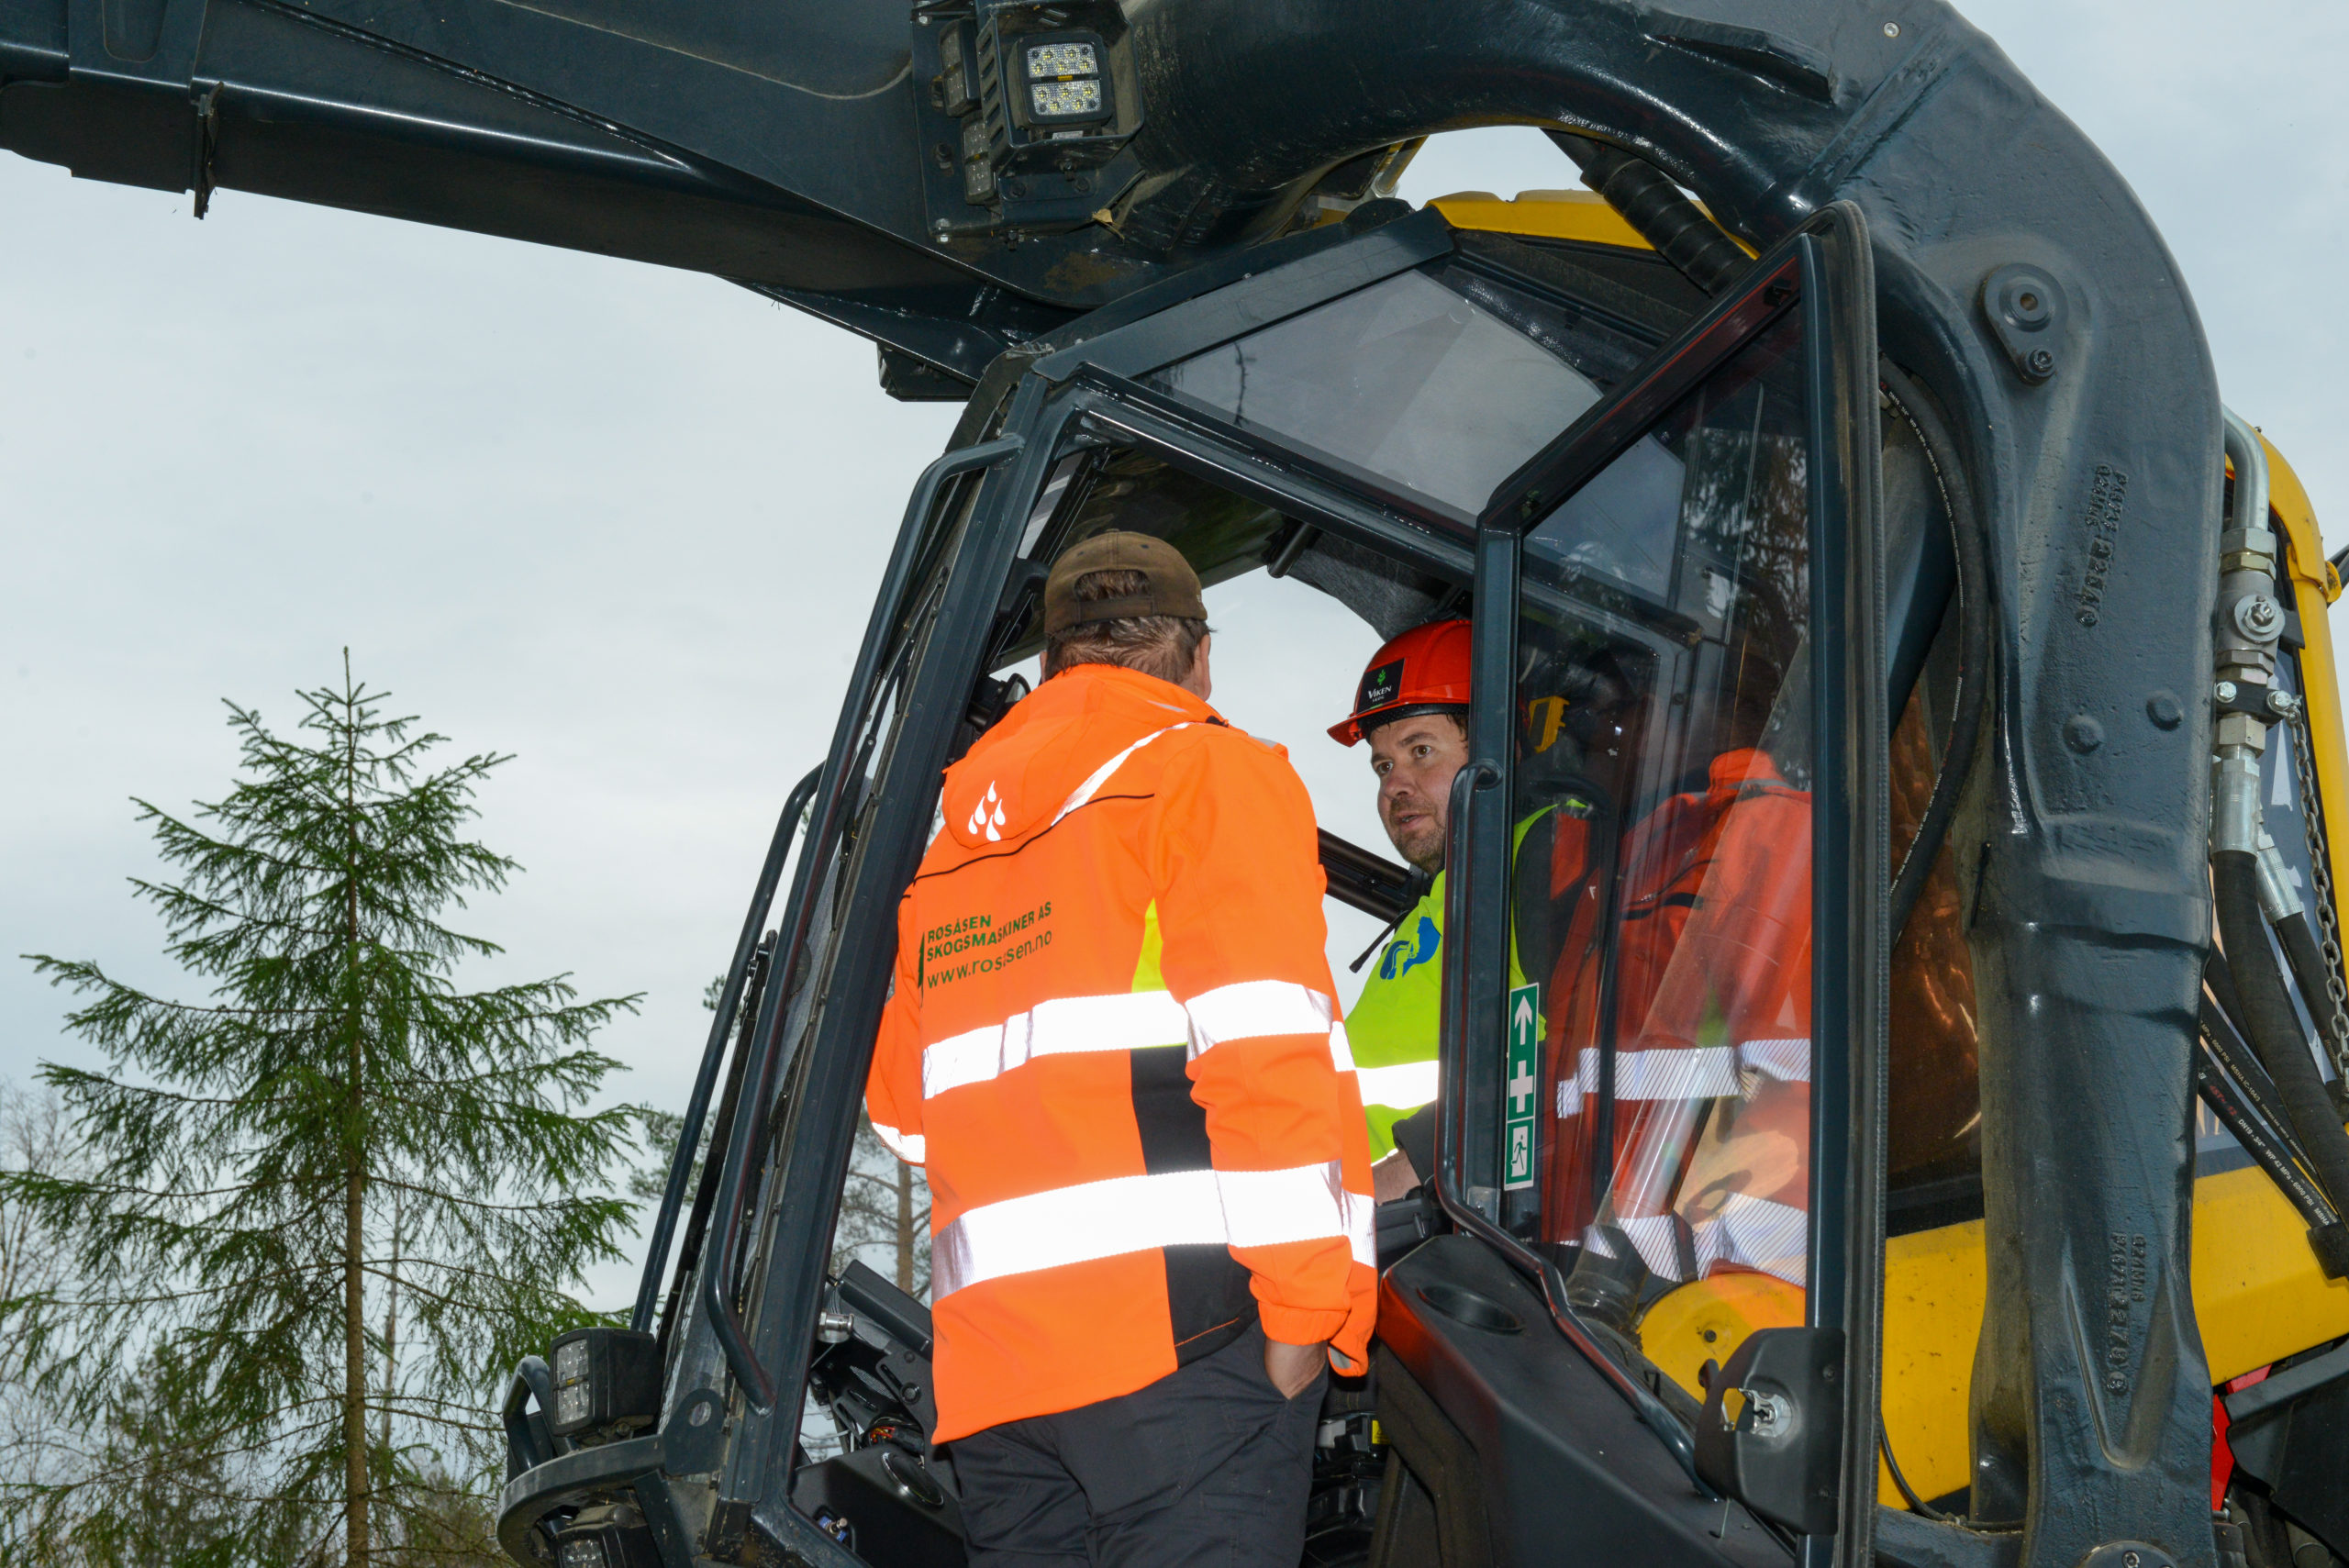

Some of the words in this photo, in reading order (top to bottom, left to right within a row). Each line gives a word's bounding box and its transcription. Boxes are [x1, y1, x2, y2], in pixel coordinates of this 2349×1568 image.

[1368, 685, 1392, 699] VIKEN
[927, 911, 1034, 962] SKOGSMASKINER
[1038, 902, 1052, 921] AS
[2229, 1062, 2244, 1082] MSHA
[2237, 1118, 2253, 1135] DN19
[2265, 1149, 2276, 1162] WP
[2273, 1158, 2282, 1168] 42
[2279, 1165, 2292, 1180] MPa
[2292, 1181, 2306, 1196] 6000
[2303, 1194, 2314, 1207] PSI
[2313, 1207, 2330, 1226] MSHA
